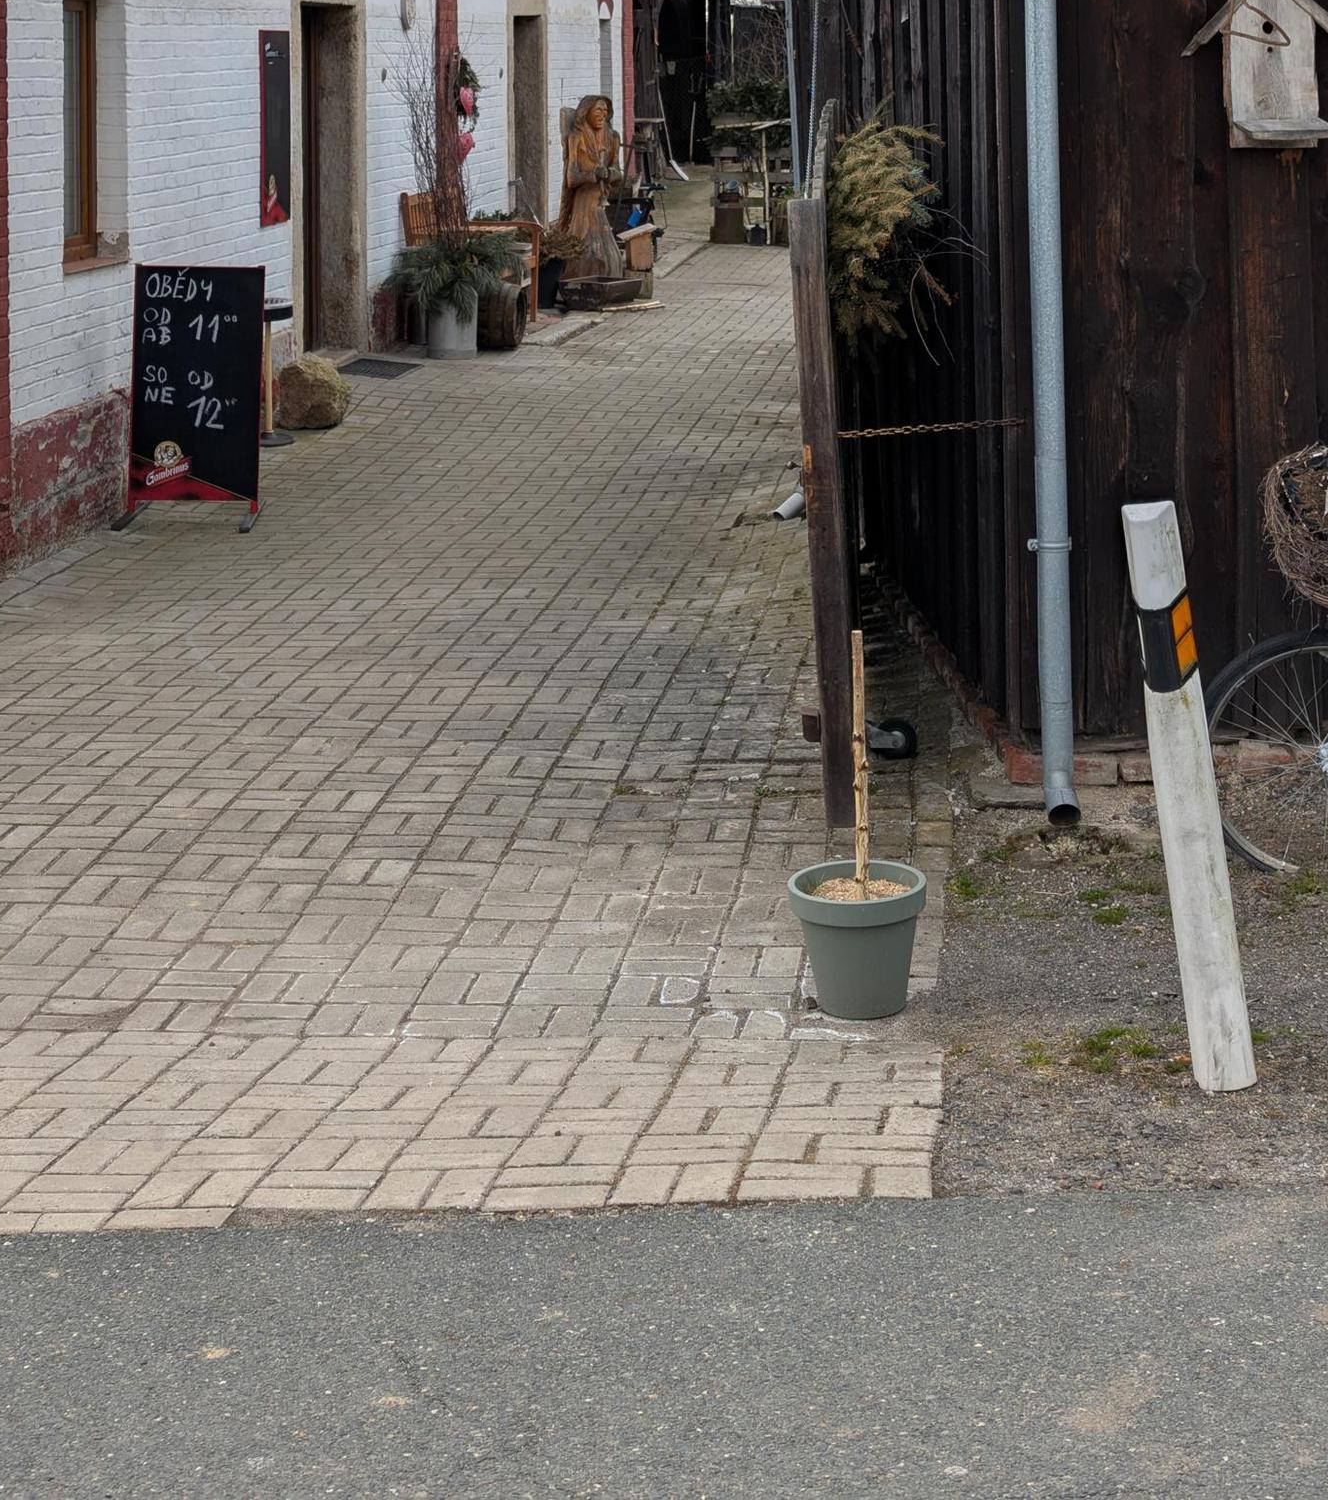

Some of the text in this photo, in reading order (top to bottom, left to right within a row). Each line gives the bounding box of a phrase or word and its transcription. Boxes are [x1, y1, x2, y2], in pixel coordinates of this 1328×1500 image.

[145, 267, 213, 303] OBĚDY
[143, 307, 171, 326] OD
[142, 326, 172, 346] AB
[142, 364, 214, 391] SO OD
[144, 385, 176, 405] NE
[145, 462, 189, 486] Gambrinus
